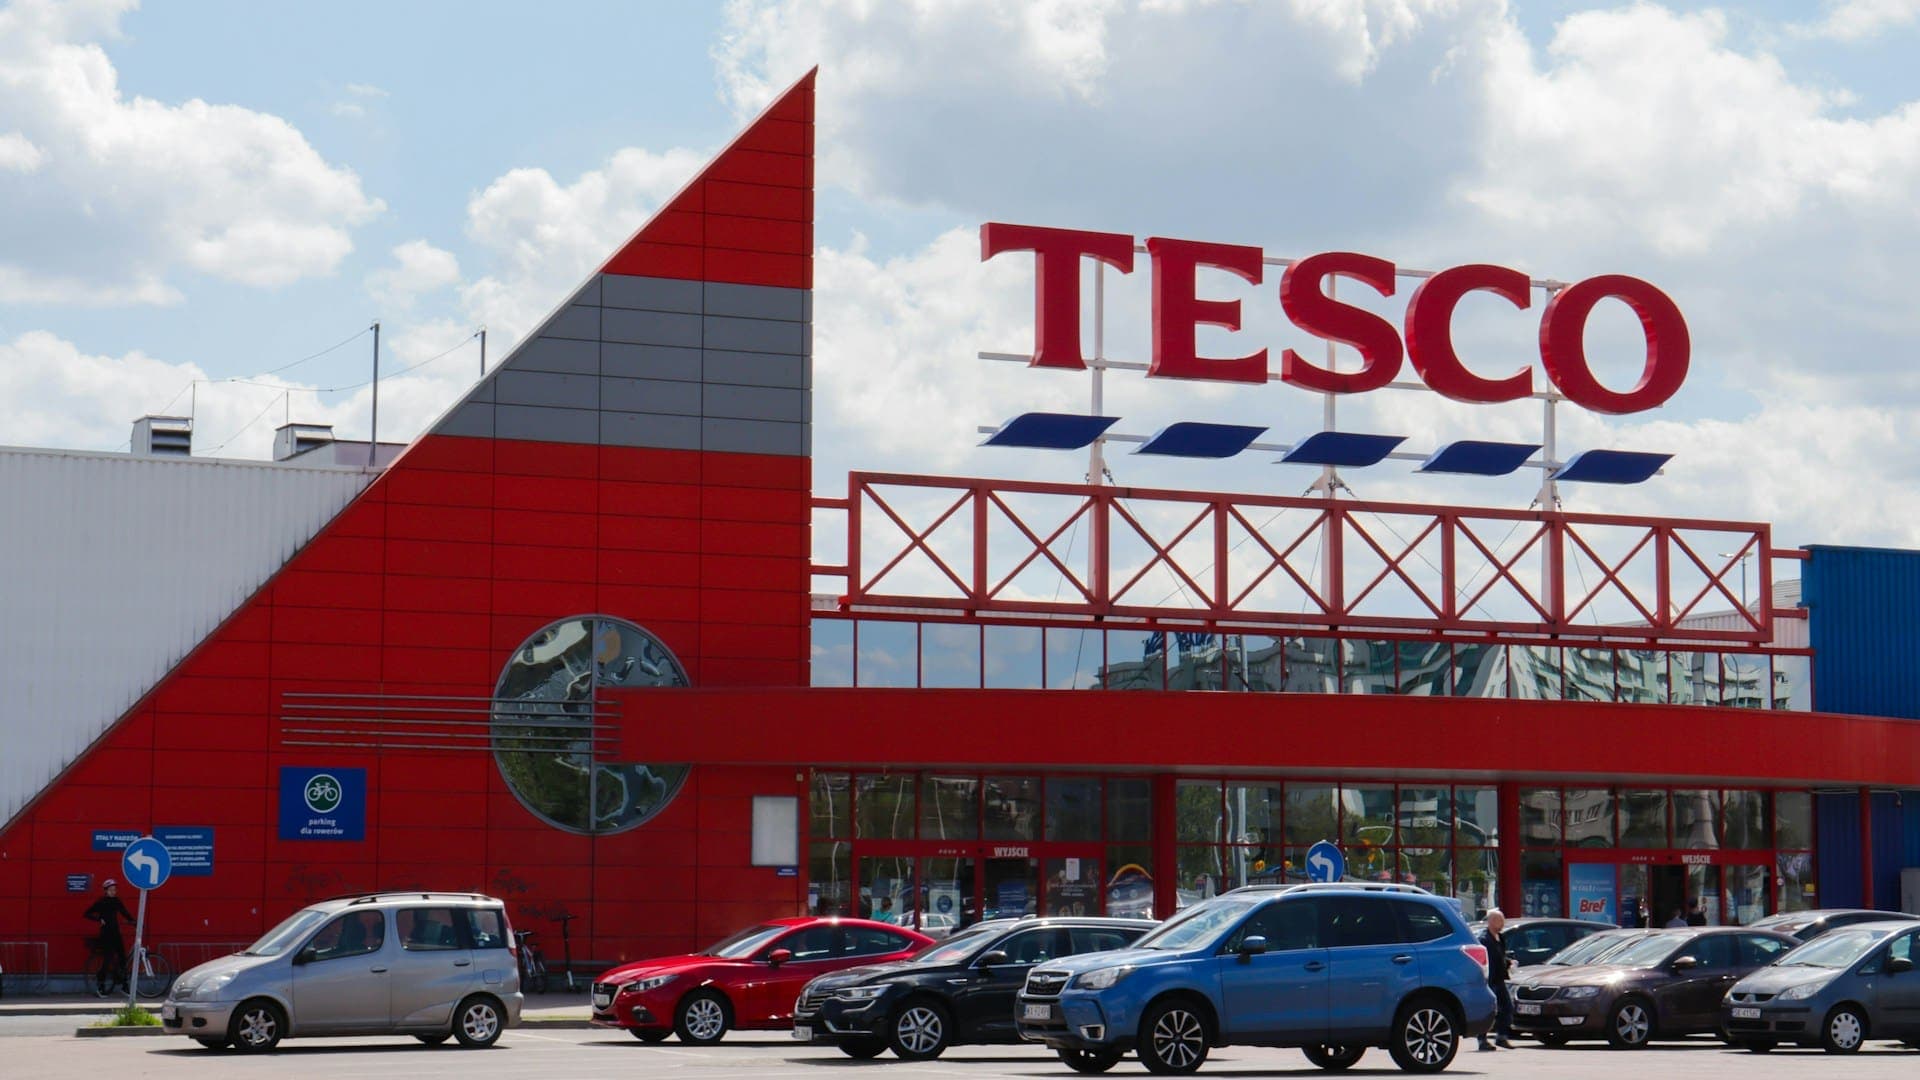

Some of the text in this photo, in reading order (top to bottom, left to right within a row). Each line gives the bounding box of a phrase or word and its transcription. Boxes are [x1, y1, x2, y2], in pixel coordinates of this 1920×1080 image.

[980, 221, 1691, 416] TESCO
[308, 818, 336, 826] parking
[994, 845, 1029, 857] WYJŚCIE
[1681, 854, 1711, 864] WEJŚCIE
[1579, 897, 1607, 913] Bref
